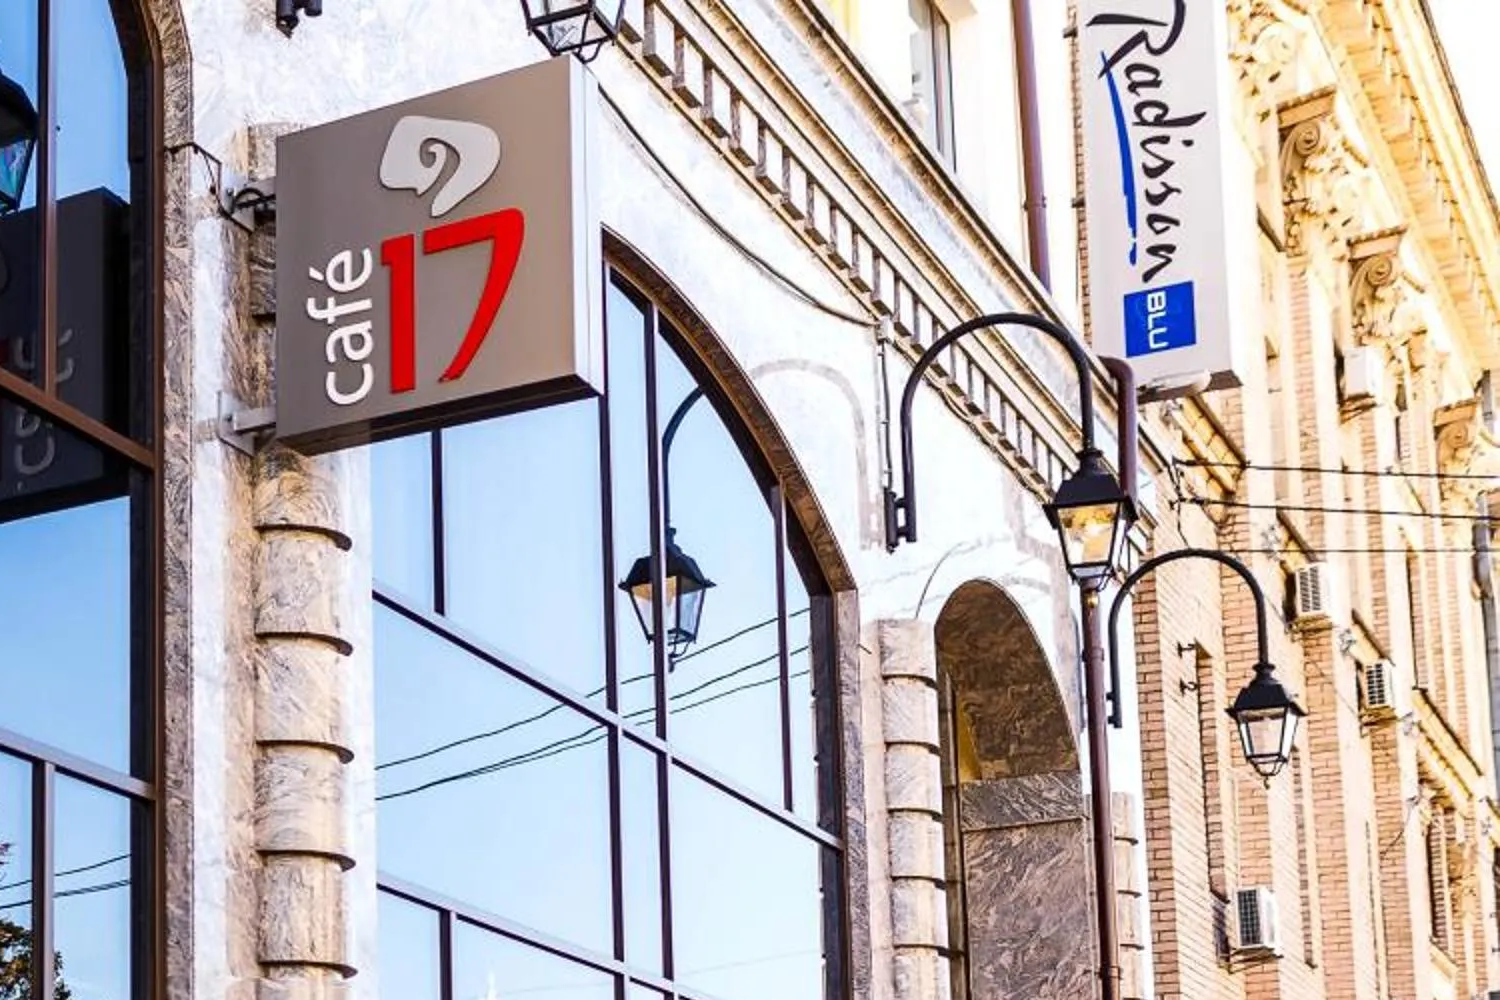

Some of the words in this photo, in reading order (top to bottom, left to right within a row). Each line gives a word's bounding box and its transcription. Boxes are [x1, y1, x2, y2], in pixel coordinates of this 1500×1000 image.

[1086, 0, 1206, 283] Radisson
[307, 248, 374, 405] café
[380, 208, 525, 394] 17
[1146, 290, 1169, 350] BLU
